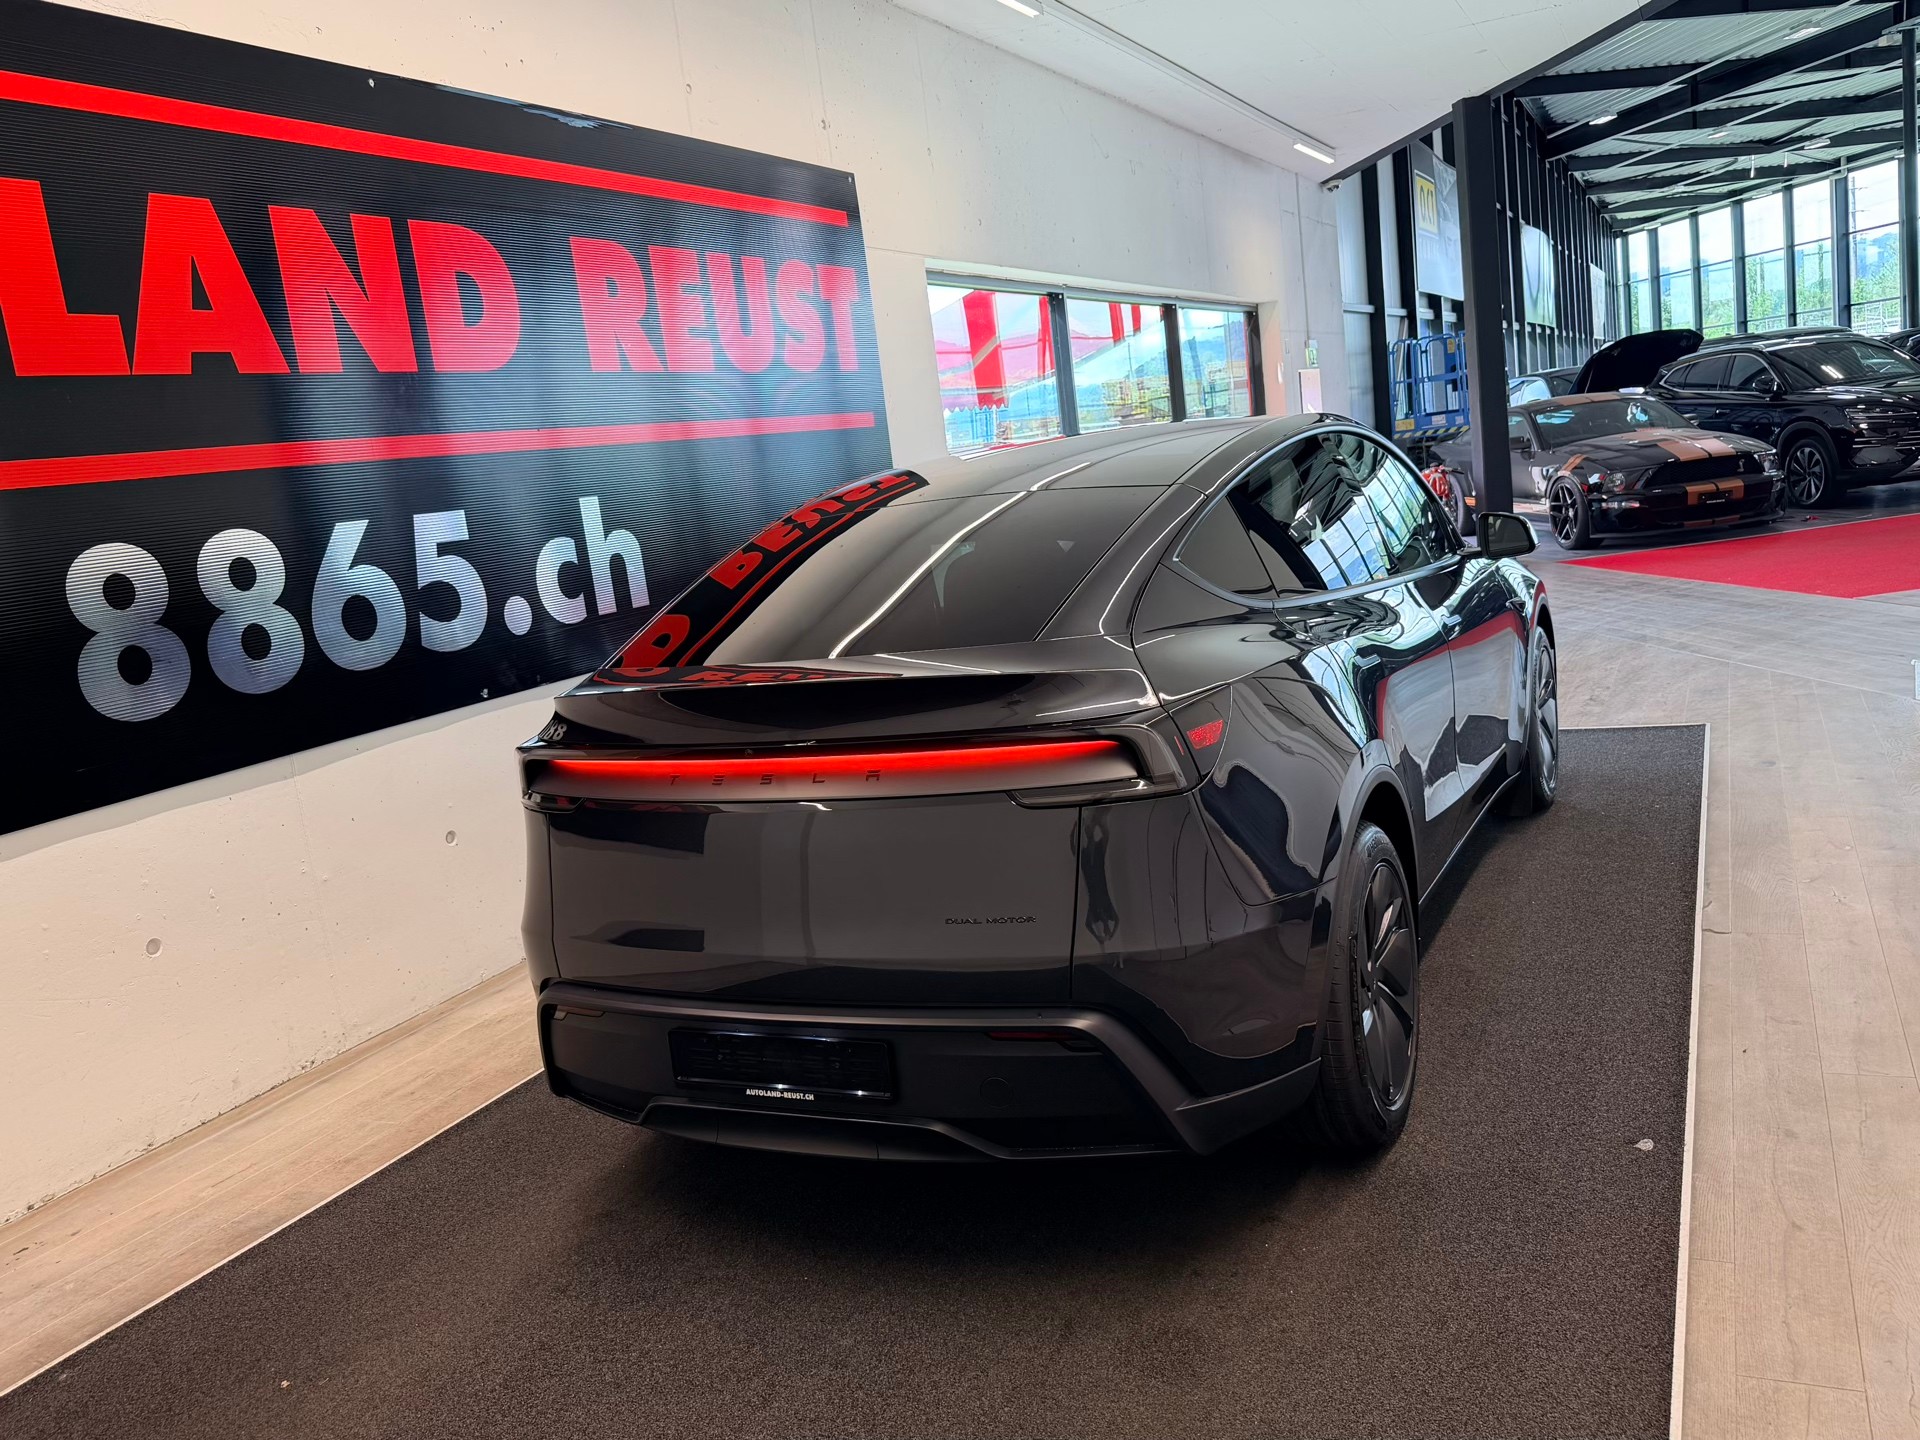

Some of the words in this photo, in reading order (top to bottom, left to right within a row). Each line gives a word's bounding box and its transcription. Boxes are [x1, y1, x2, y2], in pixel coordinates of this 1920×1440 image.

[0, 176, 521, 376] LAND
[568, 234, 860, 373] REUST
[65, 495, 651, 723] 8865.ch
[669, 769, 881, 786] TESLA
[944, 917, 982, 926] DUAL
[986, 915, 1037, 925] MOTOR
[745, 1087, 815, 1101] AUTOLAND-REUST.CH
